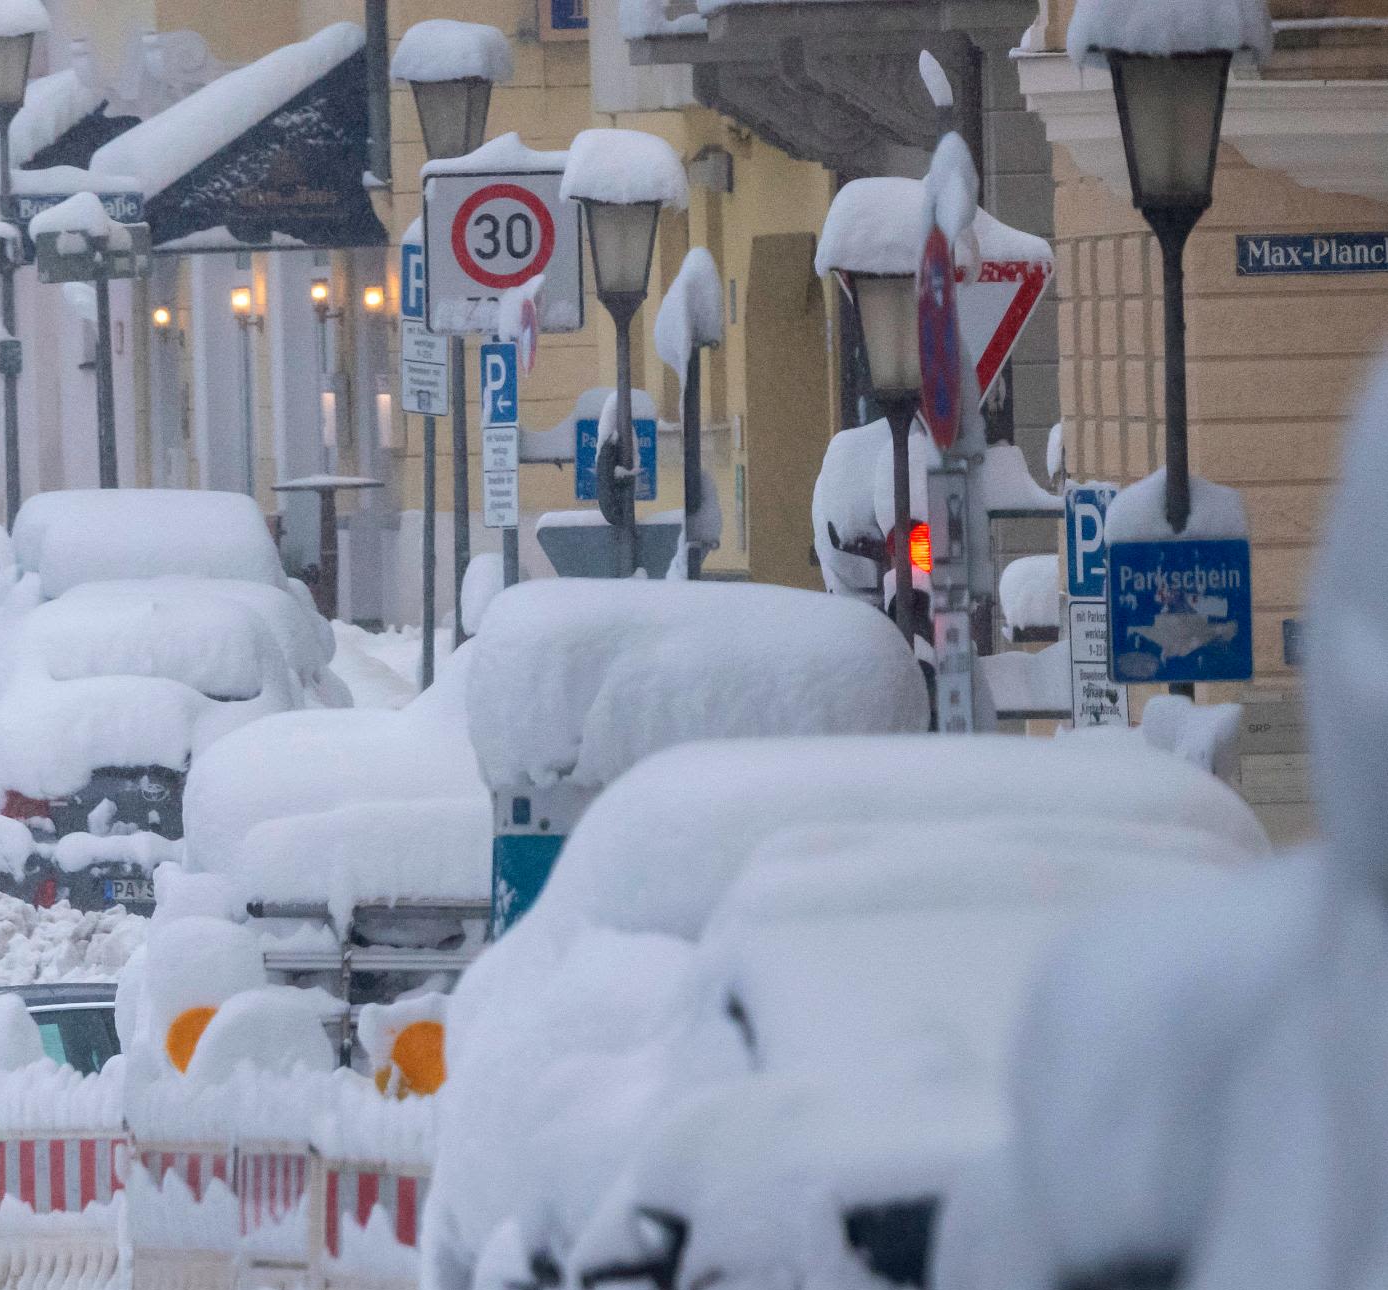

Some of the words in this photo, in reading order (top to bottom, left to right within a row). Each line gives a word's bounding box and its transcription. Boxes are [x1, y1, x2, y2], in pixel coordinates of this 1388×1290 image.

[474, 212, 533, 260] 30
[1074, 503, 1103, 583] P
[1119, 563, 1241, 592] Parkschein
[114, 881, 135, 898] PA
